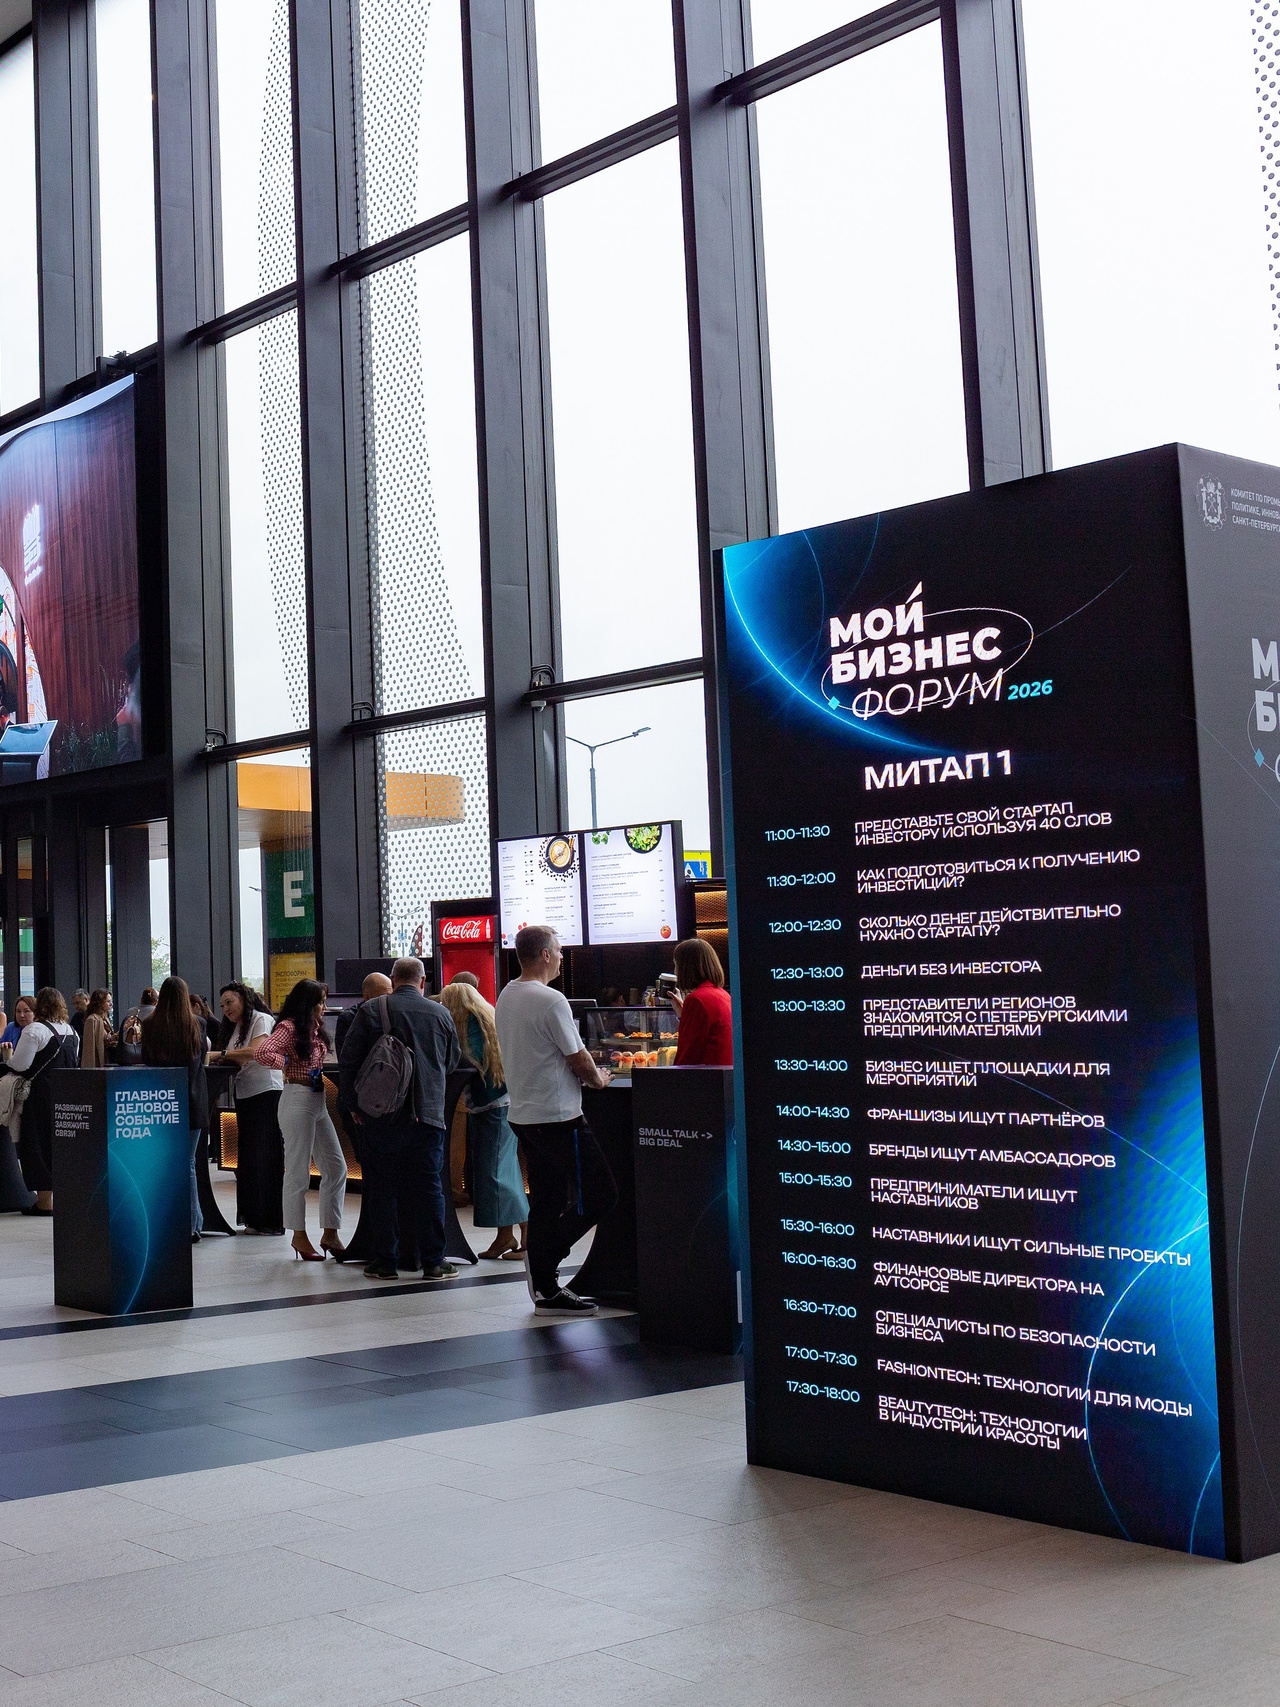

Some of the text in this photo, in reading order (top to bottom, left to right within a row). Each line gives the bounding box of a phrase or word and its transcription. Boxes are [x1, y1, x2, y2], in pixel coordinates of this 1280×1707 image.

[1231, 488, 1254, 500] КОМИТЕТ
[1256, 494, 1263, 502] ПО
[1262, 508, 1280, 519] ИННОВ
[830, 581, 924, 647] МОЙ
[831, 628, 1002, 684] БИЗНЕС
[852, 669, 1053, 720] ФОРУМ 2026
[864, 750, 1012, 791] МИТАП 1
[855, 802, 1073, 834] ПРЕДСТАВЬТЕ СВОЙ СТАРТАП
[765, 825, 830, 842] 11:00-11:30
[855, 812, 1112, 845] ИНВЕСТОРУ ИСПОЛЬЗУЯ 40 СЛОВ
[857, 849, 1140, 882] КАК ПОДГОТОВИТЬСЯ К ПОЛУЧЕНИЮ
[767, 872, 836, 887] 11:30-12:00
[857, 872, 964, 894] ИНВЕСТИЦИЙ?
[283, 870, 305, 918] E
[859, 904, 1121, 929] СКОЛЬКО ДЕНЕГ ДЕЙСТВИТЕЛЬНО
[443, 920, 483, 939] Coca-Cola
[769, 919, 841, 933] 12:00-12:30
[860, 924, 1000, 941] НУЖНО СТАРТАПУ?
[771, 966, 844, 979] 12:30-13:00
[861, 961, 1042, 979] ДЕНЬГИ БЕЗ ИНВЕСТОРА
[772, 999, 846, 1012] 13:00-13:30
[863, 996, 1076, 1012] ПРЕДСТАВИТЕЛИ РЕГИОНОВ
[863, 1009, 1127, 1024] ЗНАКОМЯТСЯ С ПЕТЕРБУРГСКИМИ
[864, 1024, 1041, 1038] ПРЕДПРИНИМАТЕЛЯМИ
[774, 1059, 848, 1072] 13:30-14:00
[866, 1060, 1111, 1078] БИЗНЕС ИЩЕТ ПЛОЩАДКИ ДЛЯ
[866, 1072, 977, 1087] МЕРОПРИЯТИЙ
[115, 1090, 175, 1101] ГЛАВНОЕ
[55, 1104, 92, 1112] РАЗВЯЖИТЕ
[115, 1102, 179, 1115] ДЕЛОВОЕ
[776, 1105, 850, 1119] 14:00-14:30
[55, 1121, 89, 1129] ЗАВЯЖИТЕ
[116, 1114, 179, 1126] СОБЫТИЕ
[867, 1108, 1106, 1128] ФРАНШИЗЫ ИЩУТ ПАРТНЁРОВ
[116, 1127, 151, 1139] ГОДА
[639, 1128, 698, 1139] SMALL TALK
[639, 1138, 682, 1147] BIG DEAL
[777, 1139, 851, 1154] 14:30-15:00
[869, 1143, 1116, 1168] БРЕНДЫ ИЩУТ АМБАССАДОРОВ
[779, 1172, 852, 1188] 15:00-15:30
[870, 1178, 1077, 1203] ПРЕДПРИНИМАТЕЛИ ИЩУТ
[871, 1191, 979, 1210] НАСТАВНИКОВ
[780, 1219, 855, 1237] 15:30-16:00
[872, 1227, 1191, 1266] НАСТАВНИКИ ИЩУТ СИЛЬНЫЕ ПРОЕКТЫ
[782, 1252, 857, 1270] 16:00-16:30
[874, 1261, 1105, 1297] ФИНАНСОВЫЕ ДИРЕКТОРА НА
[874, 1275, 950, 1294] АУТСОРСЕ
[783, 1299, 857, 1319] 16:30-17:00
[875, 1310, 1156, 1357] СПЕЦИАЛИСТЫ ПО БЕЗОПАСНОСТИ
[875, 1323, 944, 1344] БИЗНЕСА
[785, 1345, 858, 1367] 17:00-17:30
[786, 1380, 860, 1403] 17:30-18:00
[877, 1359, 1193, 1418] FASHIONTECH: ТЕХНОЛОГИИ ДЛЯ МОДЫ
[879, 1395, 1088, 1441] BEAUTYTECH: ТЕХНОЛОГИИ
[879, 1408, 1060, 1450] В ИНДУСТРИИ КРАСОТЫ
